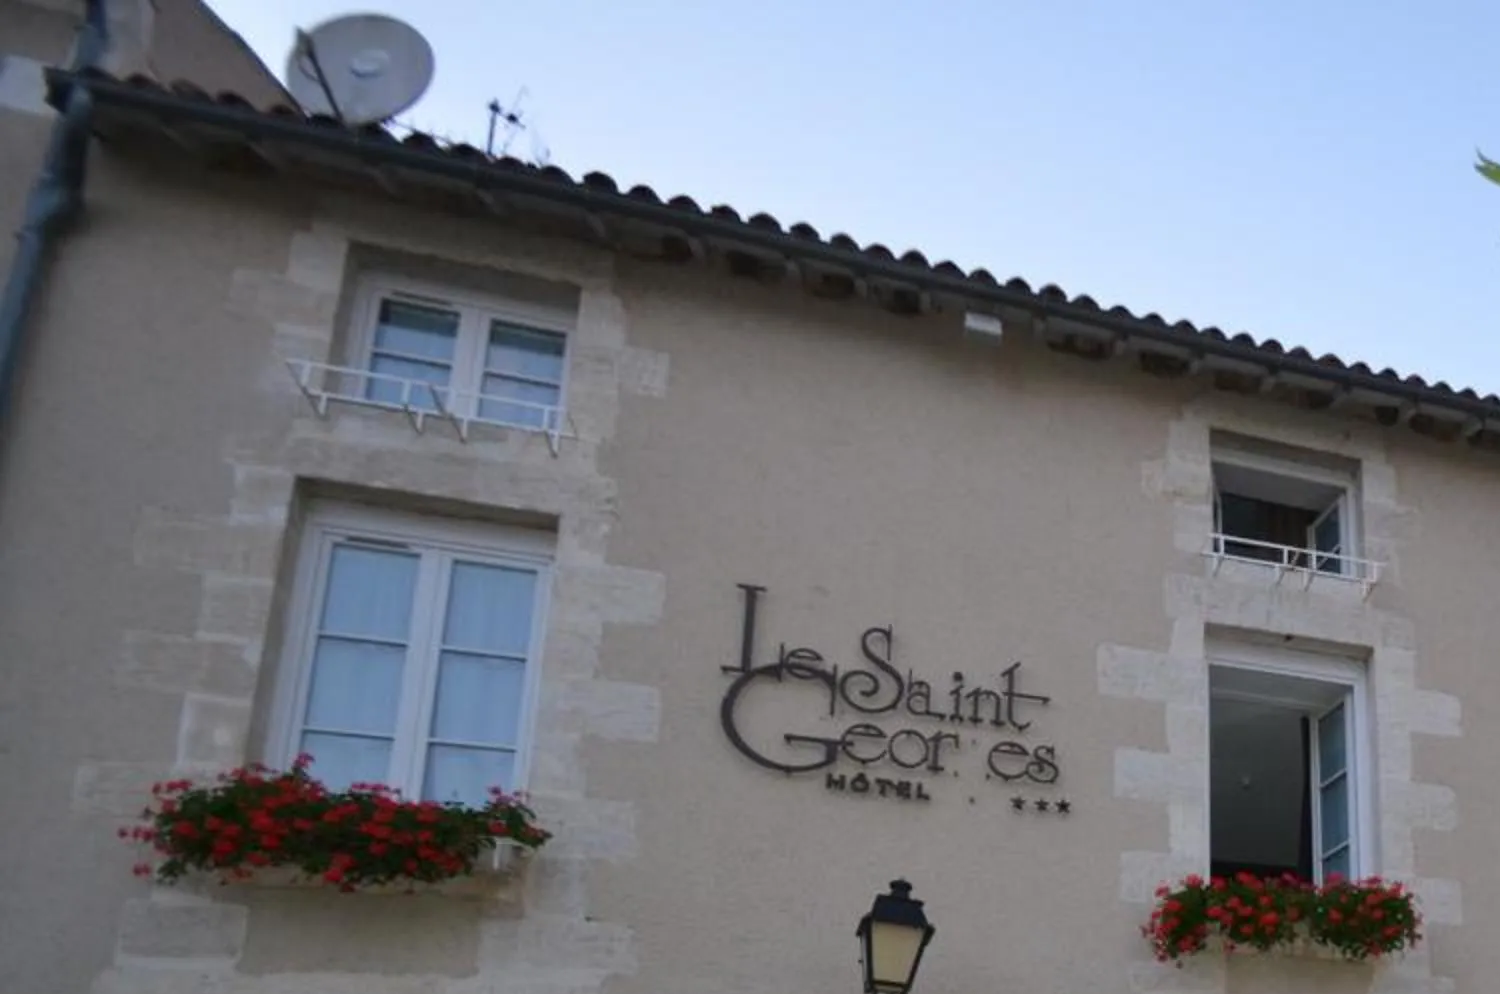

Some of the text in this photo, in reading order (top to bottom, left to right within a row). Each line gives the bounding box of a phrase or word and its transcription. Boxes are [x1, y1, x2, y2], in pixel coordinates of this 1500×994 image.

[720, 583, 1051, 731] Le Saint
[720, 663, 1060, 784] Geores
[825, 772, 931, 801] HÔTEL
